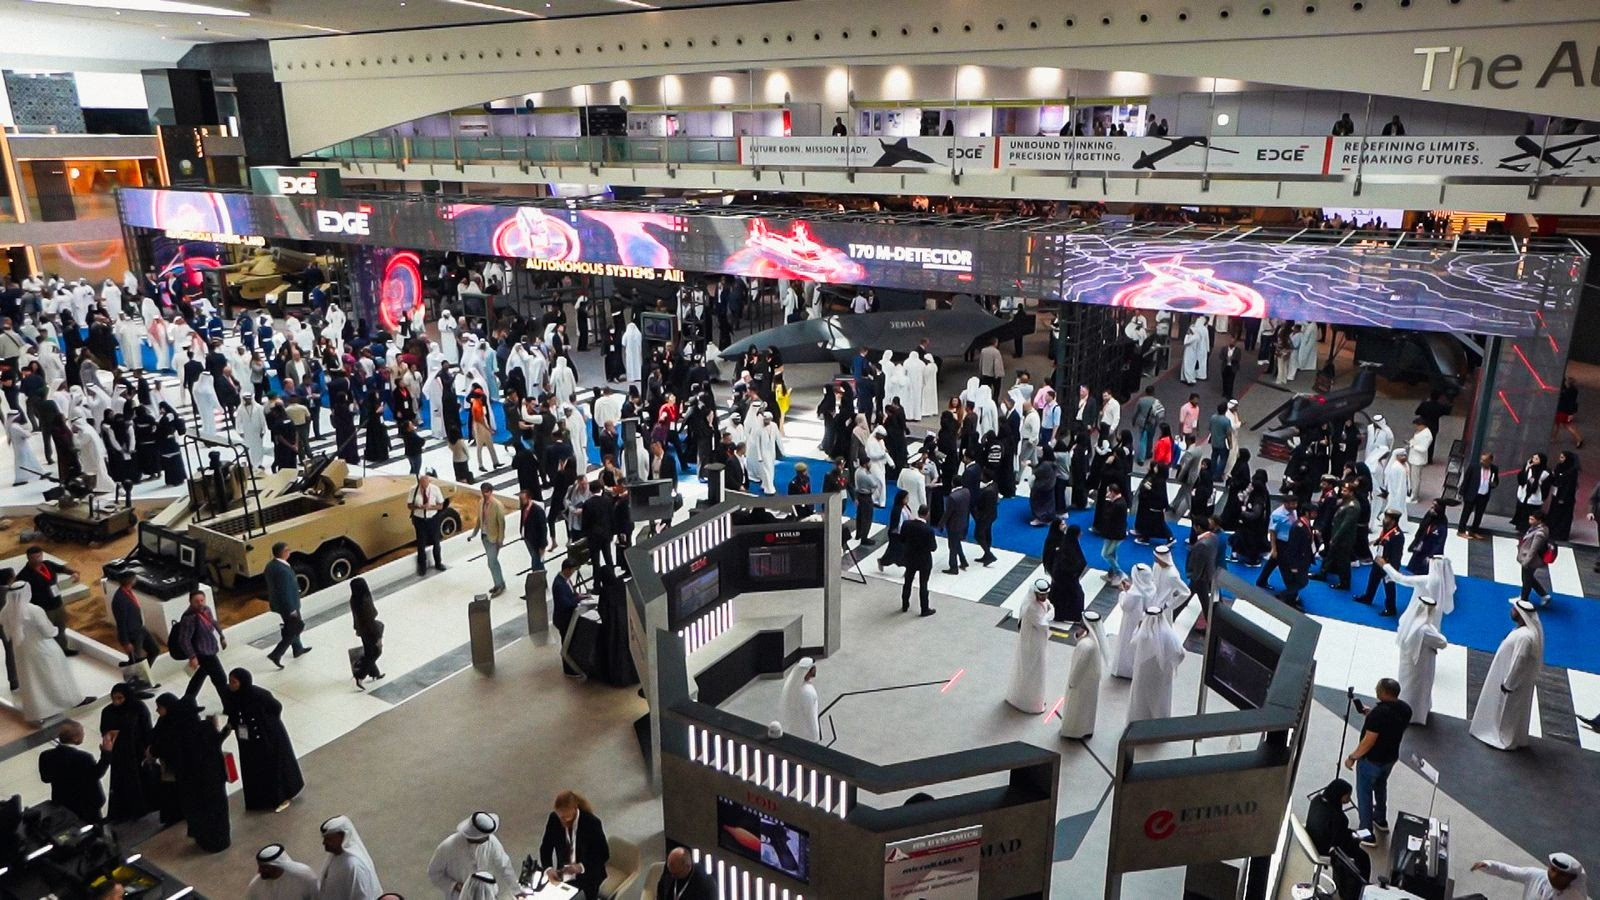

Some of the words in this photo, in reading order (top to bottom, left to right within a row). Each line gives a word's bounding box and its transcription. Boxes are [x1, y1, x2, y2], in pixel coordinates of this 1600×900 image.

[1414, 46, 1523, 92] The
[750, 145, 777, 153] FUTURE
[805, 145, 839, 154] MISSION
[1010, 141, 1061, 149] UNBOUND
[1344, 141, 1425, 151] REDEFINING
[1430, 141, 1479, 151] LIMITS.
[947, 148, 983, 159] EDGE
[1009, 151, 1061, 161] PRECISION
[1257, 148, 1305, 161] EDGE
[1342, 154, 1413, 165] REMAKING
[1417, 154, 1484, 165] FUTURES.
[278, 176, 317, 195] EDGE
[316, 210, 370, 236] EDGE
[848, 243, 875, 259] 170
[876, 244, 973, 266] M-DETECTOR
[526, 258, 604, 276] AUTONOMOUS
[605, 264, 655, 280] SYSTEMS
[1181, 800, 1259, 822] ETIMAD
